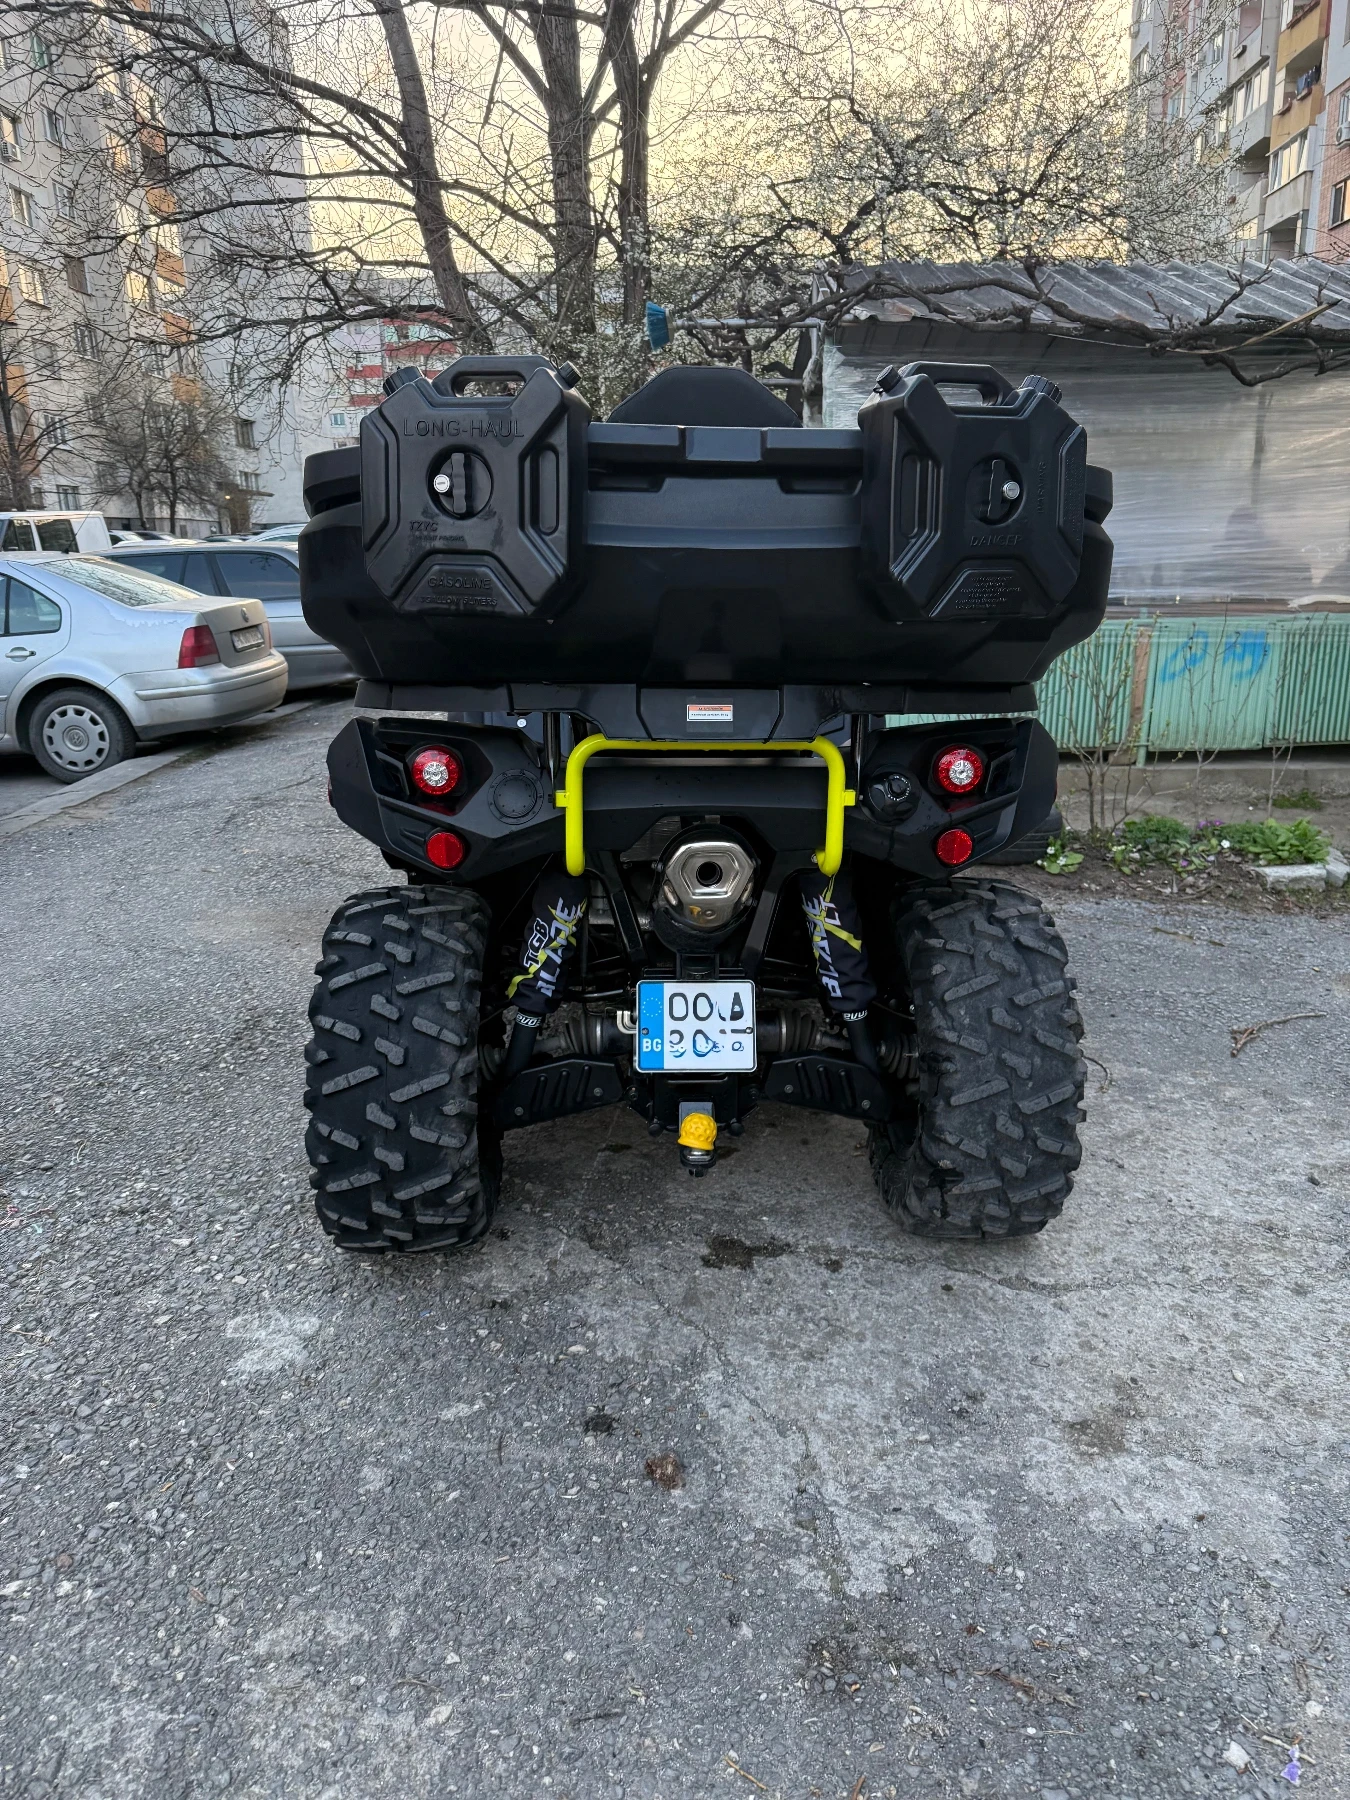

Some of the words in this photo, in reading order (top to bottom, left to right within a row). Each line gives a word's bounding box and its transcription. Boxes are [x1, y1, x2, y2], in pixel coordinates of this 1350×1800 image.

[402, 418, 525, 438] LONG-HAUL
[428, 575, 492, 590] GASOLINE
[523, 917, 549, 968] TGB
[642, 1038, 662, 1052] BG
